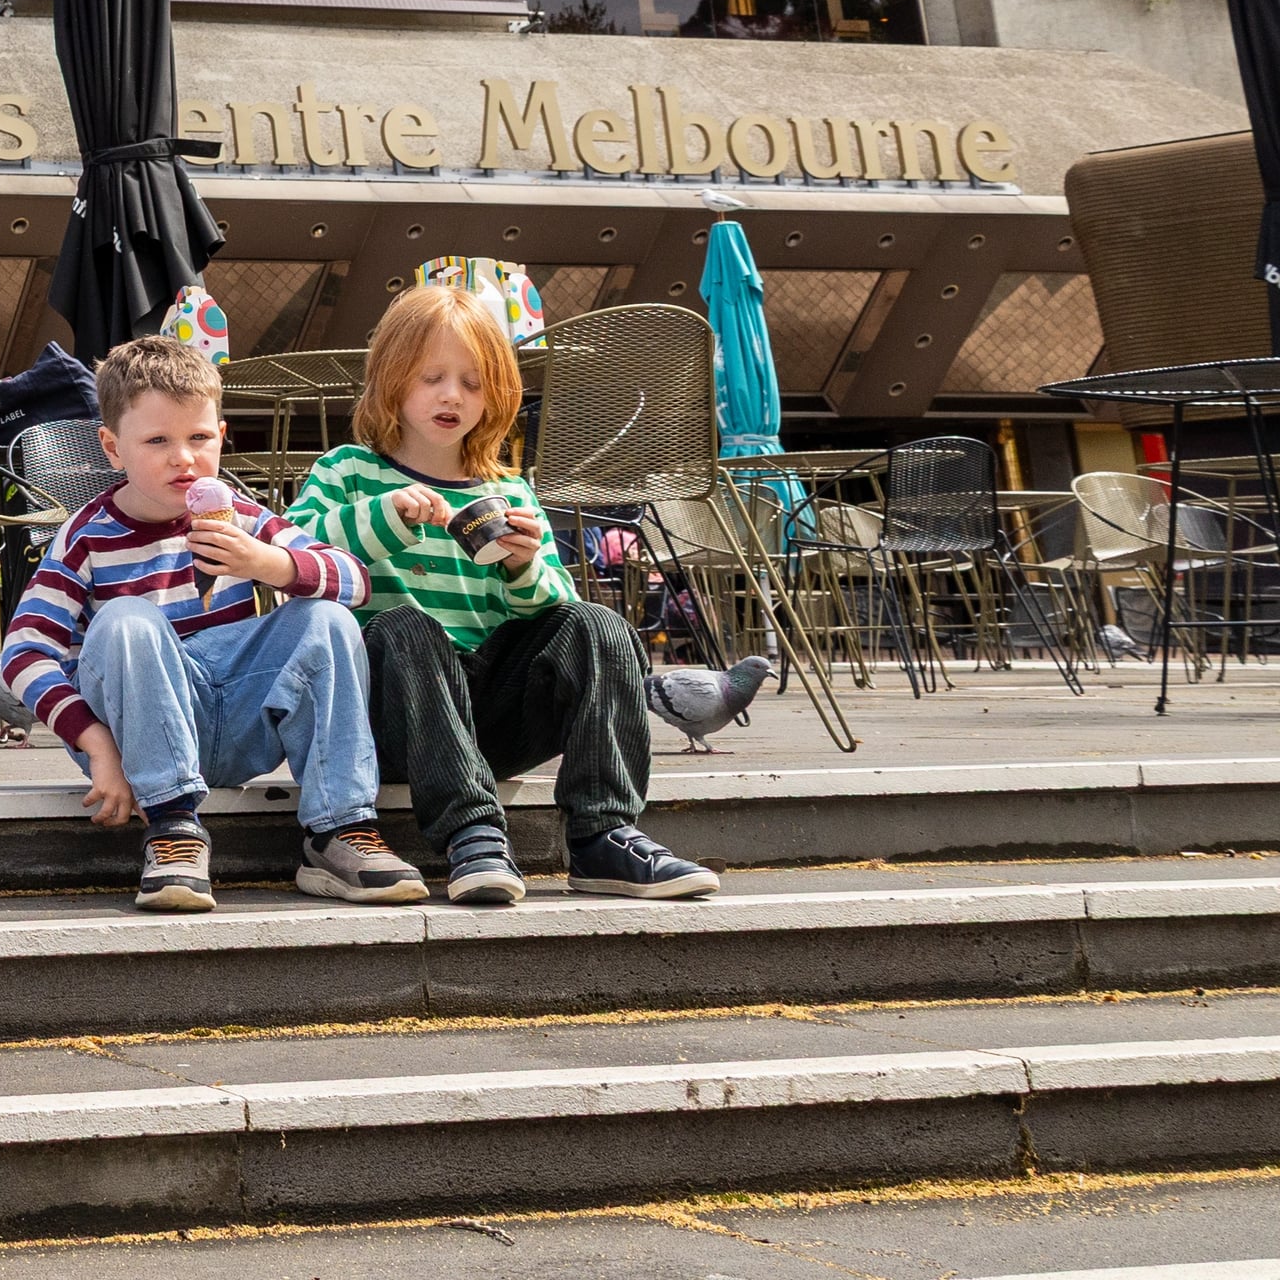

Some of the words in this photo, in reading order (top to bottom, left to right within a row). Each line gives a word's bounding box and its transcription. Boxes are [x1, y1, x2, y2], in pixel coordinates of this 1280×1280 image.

[176, 80, 438, 171] entre
[477, 77, 1018, 184] Melbourne
[0, 407, 26, 425] LABEL
[462, 509, 502, 535] CONNOIS
